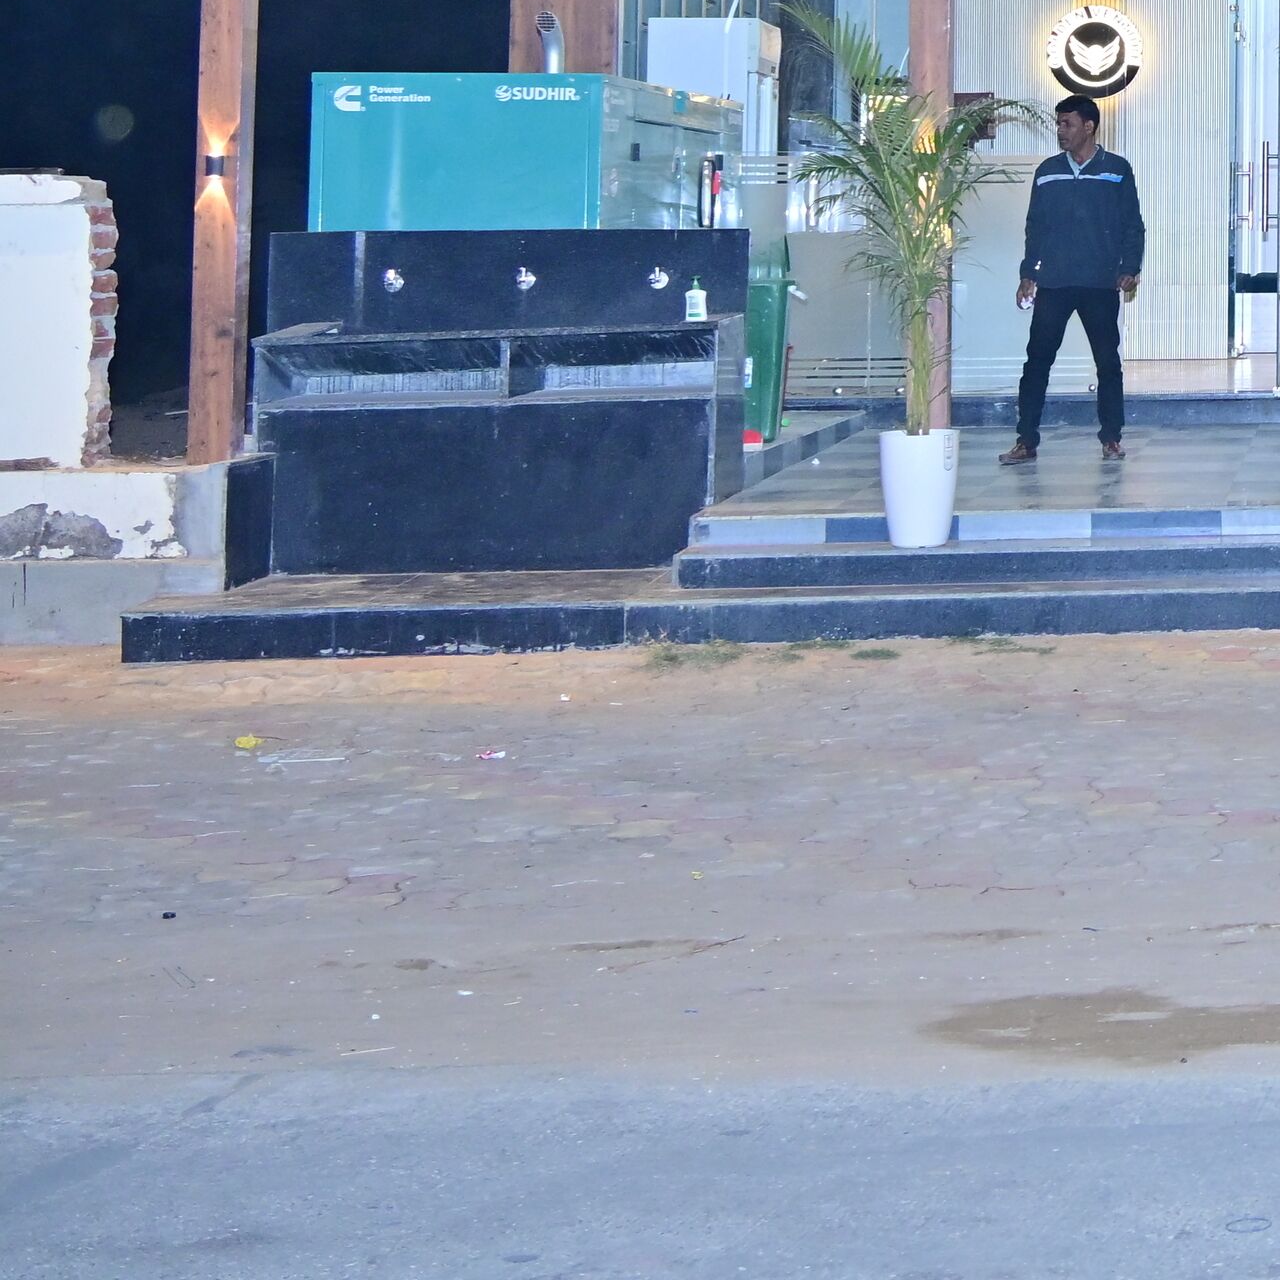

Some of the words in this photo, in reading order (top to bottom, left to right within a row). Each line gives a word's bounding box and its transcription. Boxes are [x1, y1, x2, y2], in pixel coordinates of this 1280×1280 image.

[369, 85, 405, 95] Power
[512, 87, 576, 101] SUDHIR
[369, 93, 432, 103] Generation
